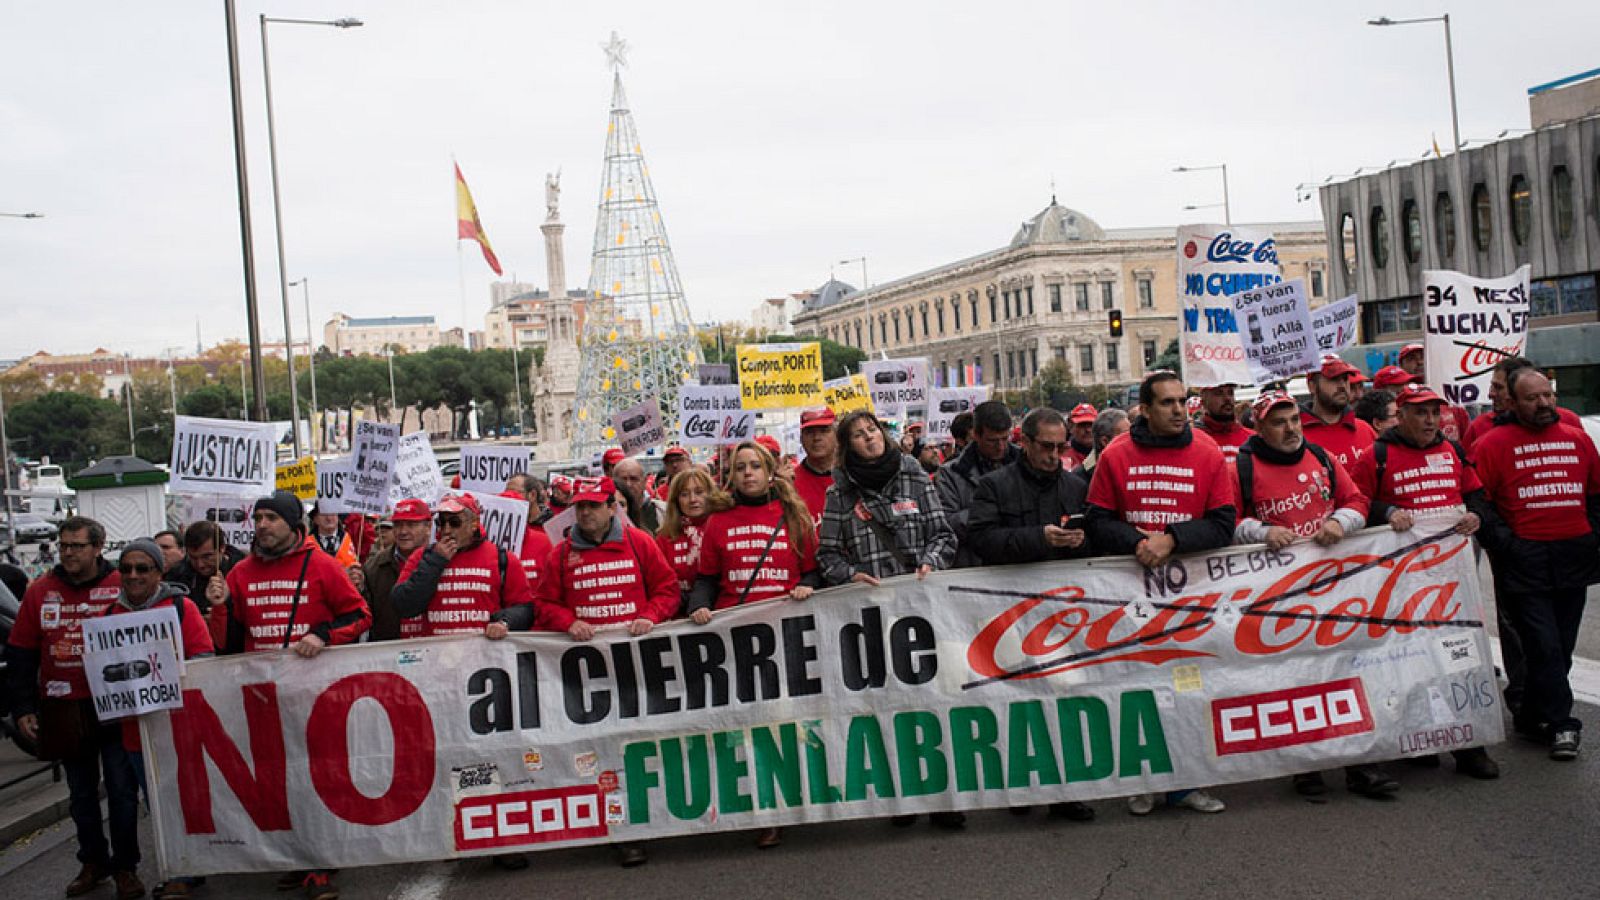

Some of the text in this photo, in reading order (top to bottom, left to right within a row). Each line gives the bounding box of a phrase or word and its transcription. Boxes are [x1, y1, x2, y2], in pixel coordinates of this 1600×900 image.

[1185, 273, 1204, 297] NO
[1266, 285, 1294, 299] van
[1426, 285, 1457, 307] 34
[1261, 299, 1297, 318] fuera?
[1272, 321, 1304, 339] ¡Allá
[1427, 312, 1509, 337] LUCHA,
[1247, 336, 1307, 359] la beban!
[740, 355, 782, 375] Compra,
[783, 354, 805, 371] POR
[742, 381, 751, 397] la
[878, 391, 896, 403] PAN
[1442, 383, 1480, 403] NO
[683, 396, 741, 410] Contra la Just
[929, 419, 951, 433] MI PA
[176, 432, 270, 481] ¡JUSTICIA!
[1523, 443, 1539, 453] NOS
[1138, 464, 1154, 475] NOS
[1525, 457, 1541, 468] NOS
[1136, 481, 1151, 491] NOS
[233, 530, 256, 546] ROB
[481, 503, 522, 552] ICIA!
[1143, 551, 1296, 599] NO BEBAS
[466, 605, 939, 736] al CIERRE de
[95, 694, 112, 713] MI
[113, 690, 136, 710] PAN
[1220, 688, 1364, 745] CCOO
[1399, 723, 1474, 755] LUCHANDO
[170, 670, 437, 837] NO
[622, 688, 1175, 825] FUENLABRADA
[460, 793, 600, 841] CCOO
